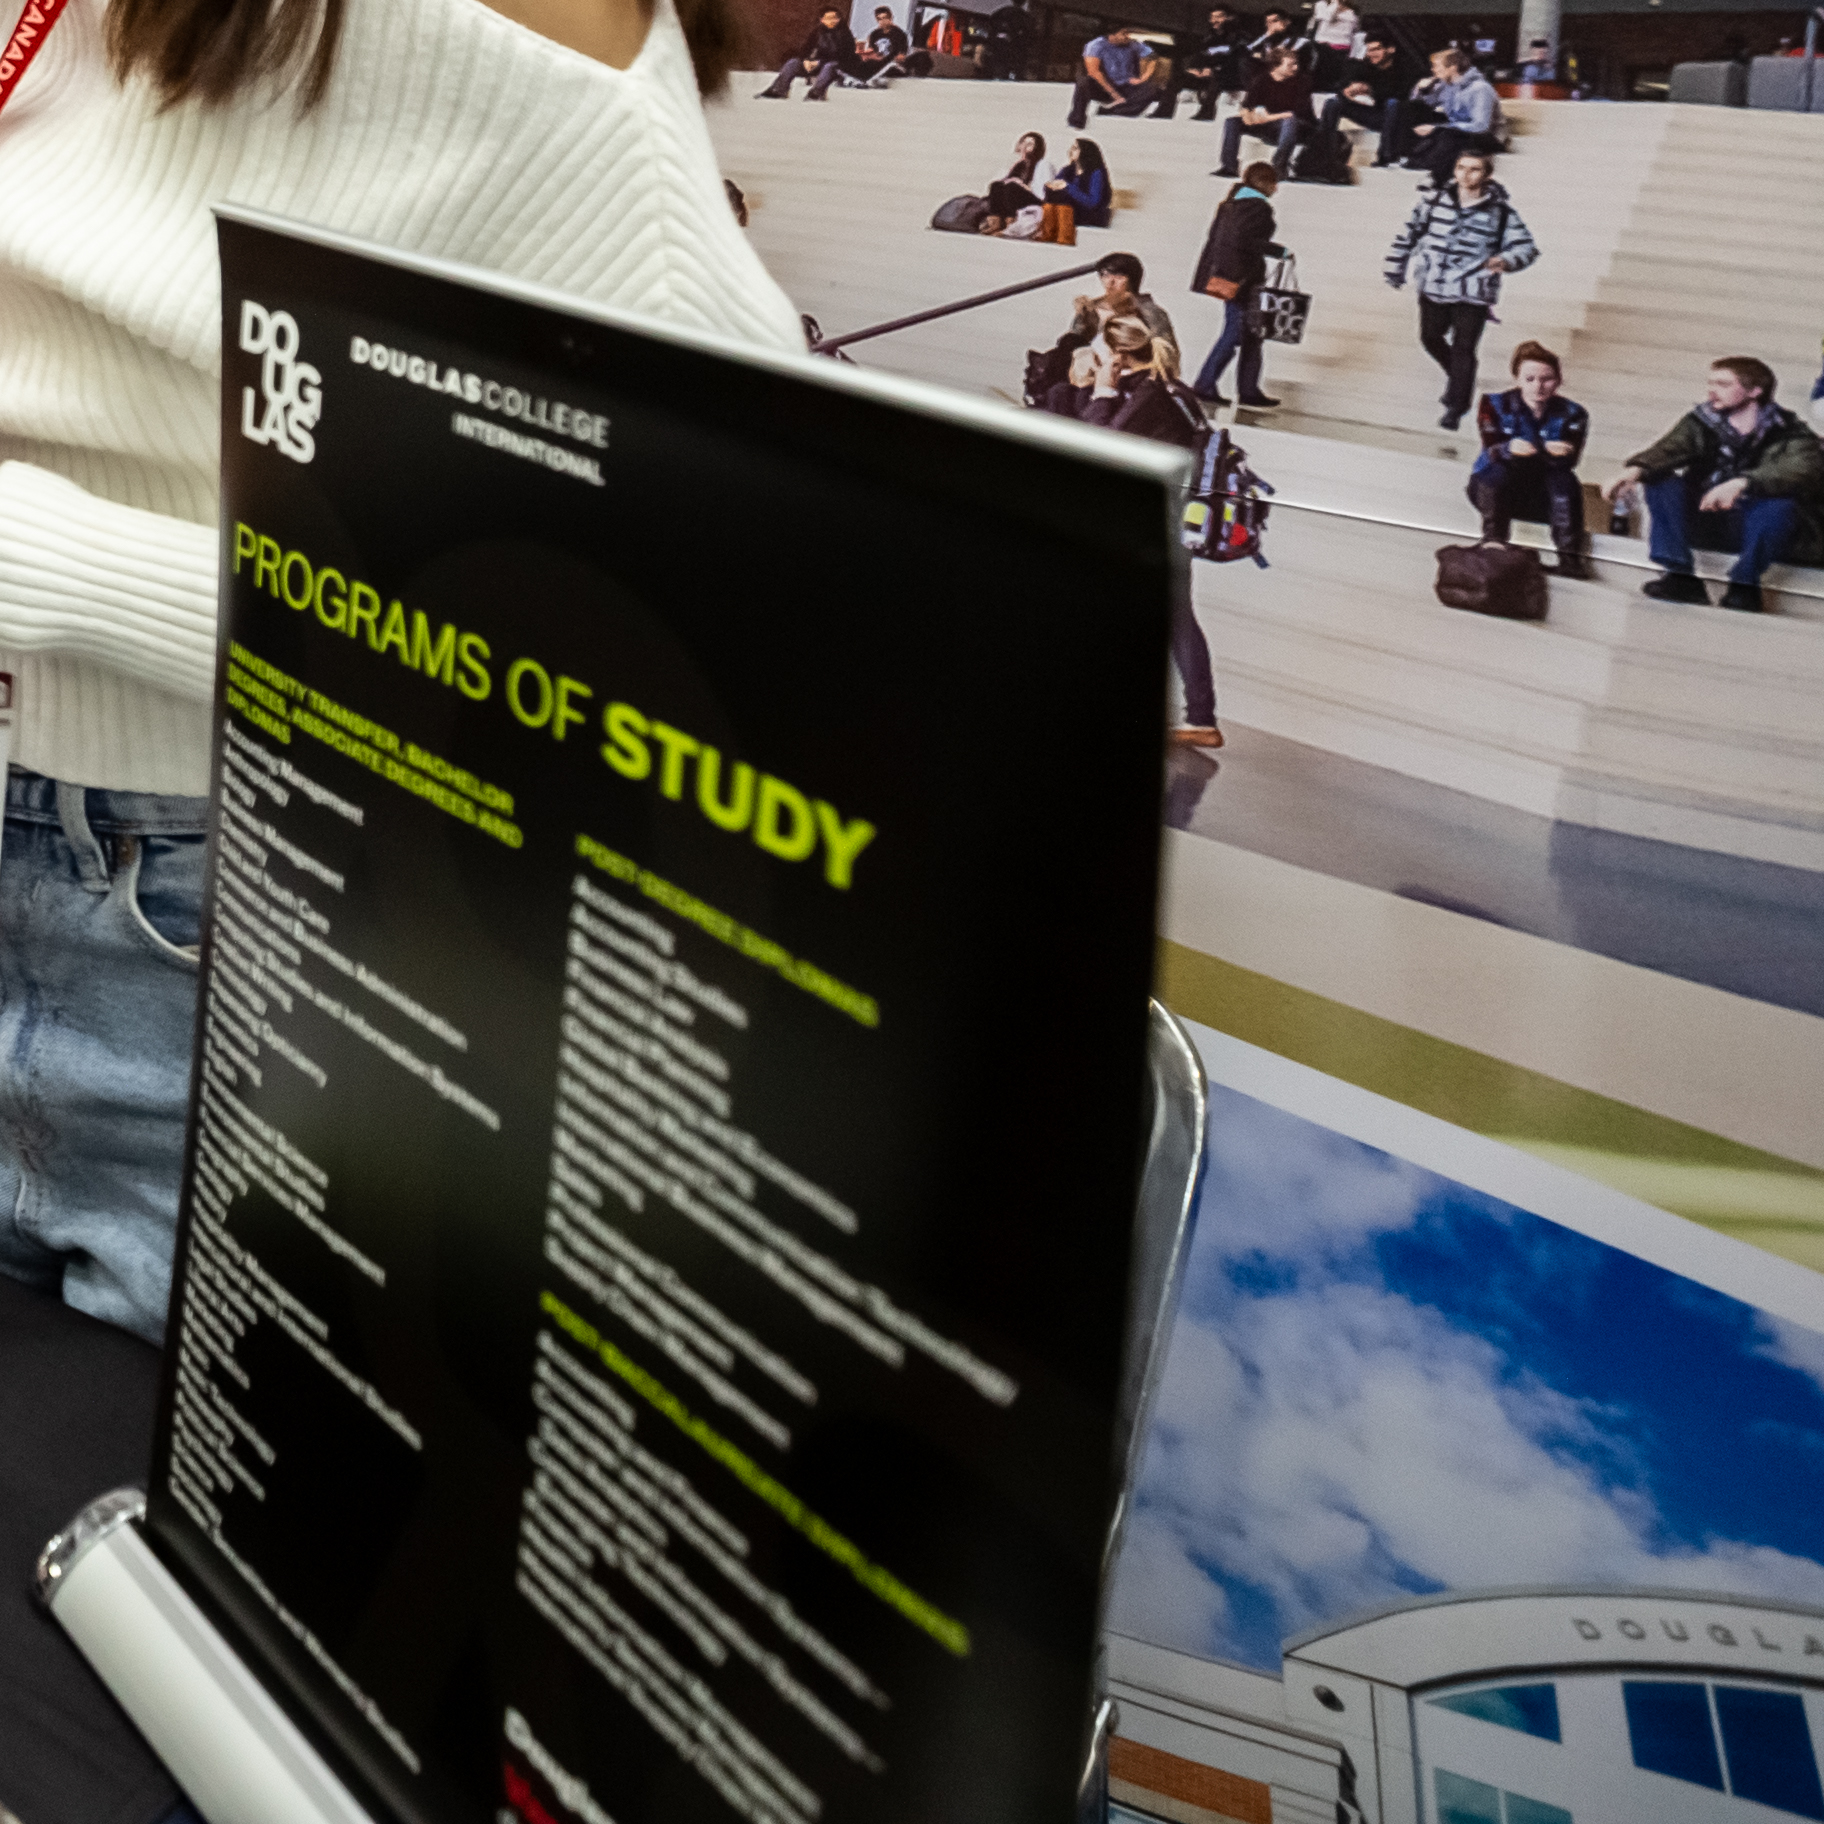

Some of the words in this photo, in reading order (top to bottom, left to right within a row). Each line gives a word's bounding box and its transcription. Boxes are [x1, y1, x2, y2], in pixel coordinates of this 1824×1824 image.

[453, 412, 605, 486] INTERNATIONAL
[225, 686, 291, 747] DIPLOMAS
[229, 640, 307, 704] UNIVERSITY
[308, 686, 407, 762] TRANSFER,
[407, 738, 514, 821] BACHELOR
[233, 521, 491, 702] PROGRAMS
[506, 657, 592, 744] OF
[602, 702, 876, 891] STUDY
[292, 700, 382, 775] ASSOCIATE
[384, 752, 477, 829] DEGREES
[478, 805, 524, 853] AND
[1572, 1616, 1824, 1659] DOUGLA
